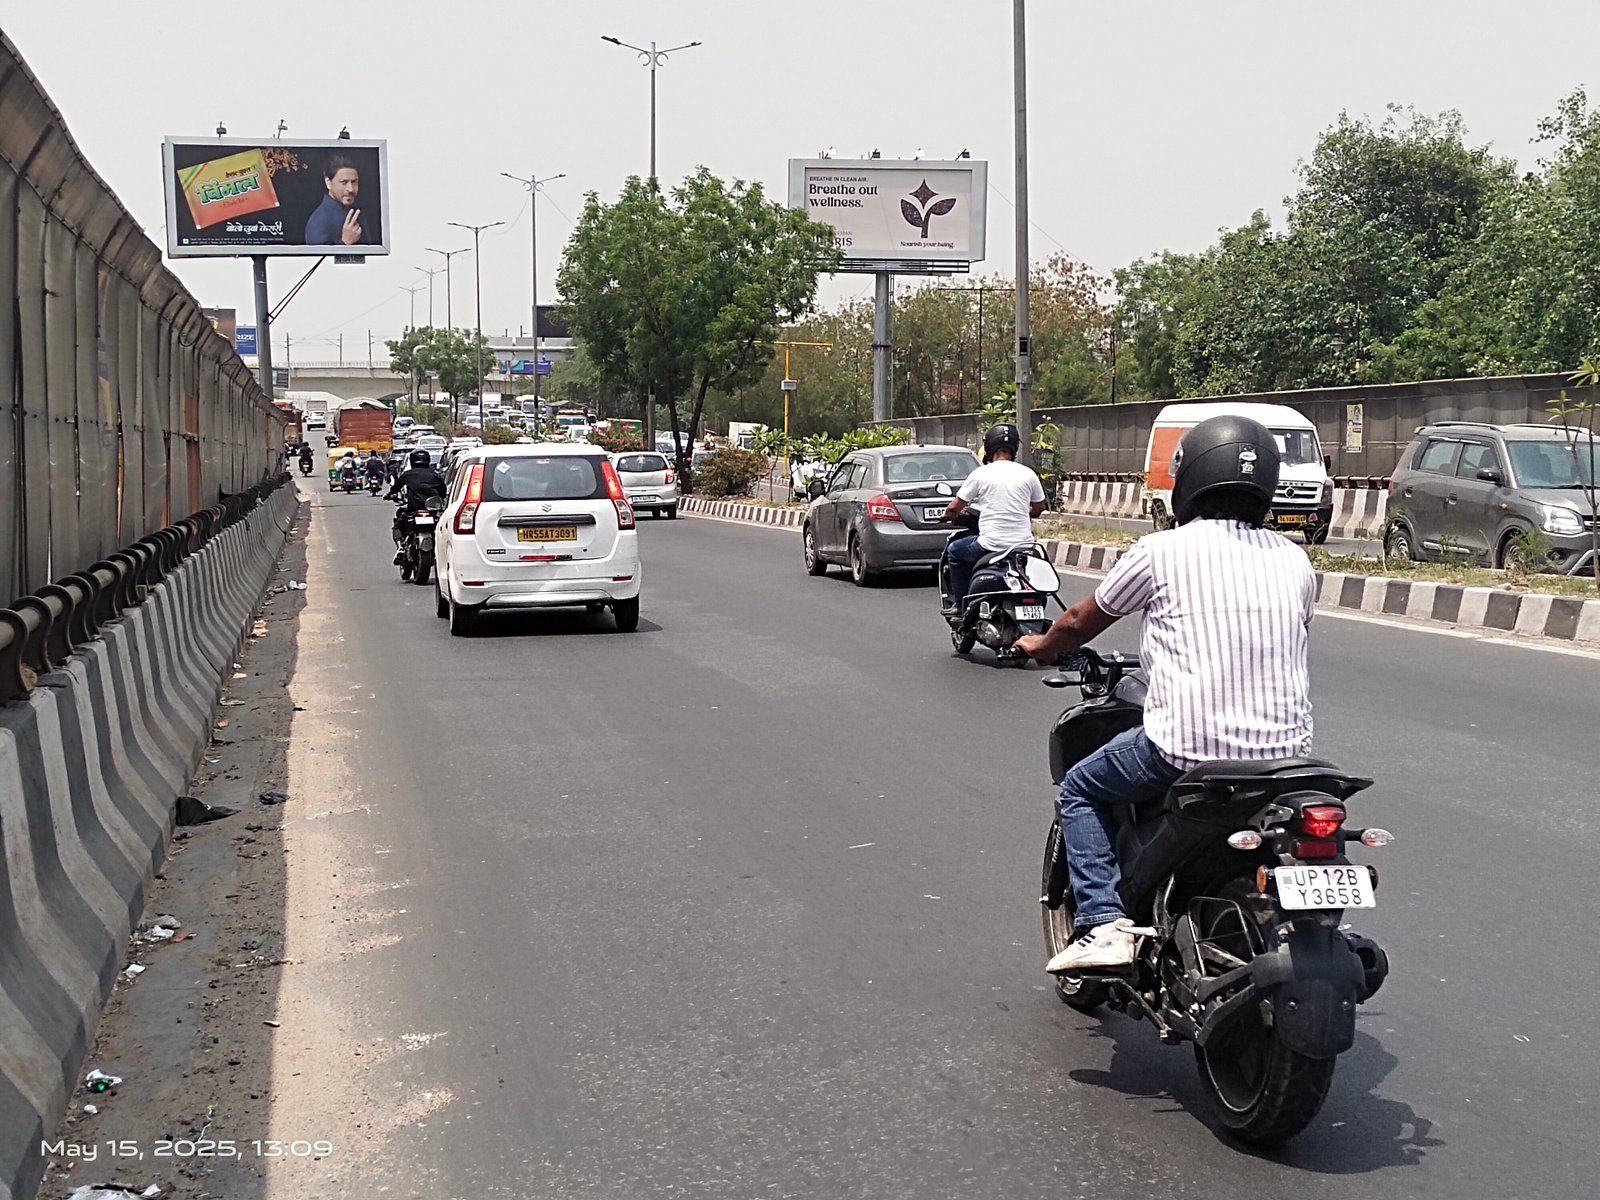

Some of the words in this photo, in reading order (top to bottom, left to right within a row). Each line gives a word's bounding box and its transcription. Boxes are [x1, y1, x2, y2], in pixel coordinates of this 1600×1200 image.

[809, 184, 856, 195] Breathe
[858, 185, 879, 195] out
[809, 197, 864, 208] wellness.
[522, 529, 576, 540] HR55AT3091
[1294, 869, 1358, 887] UP12B
[1298, 889, 1362, 906] Y3658
